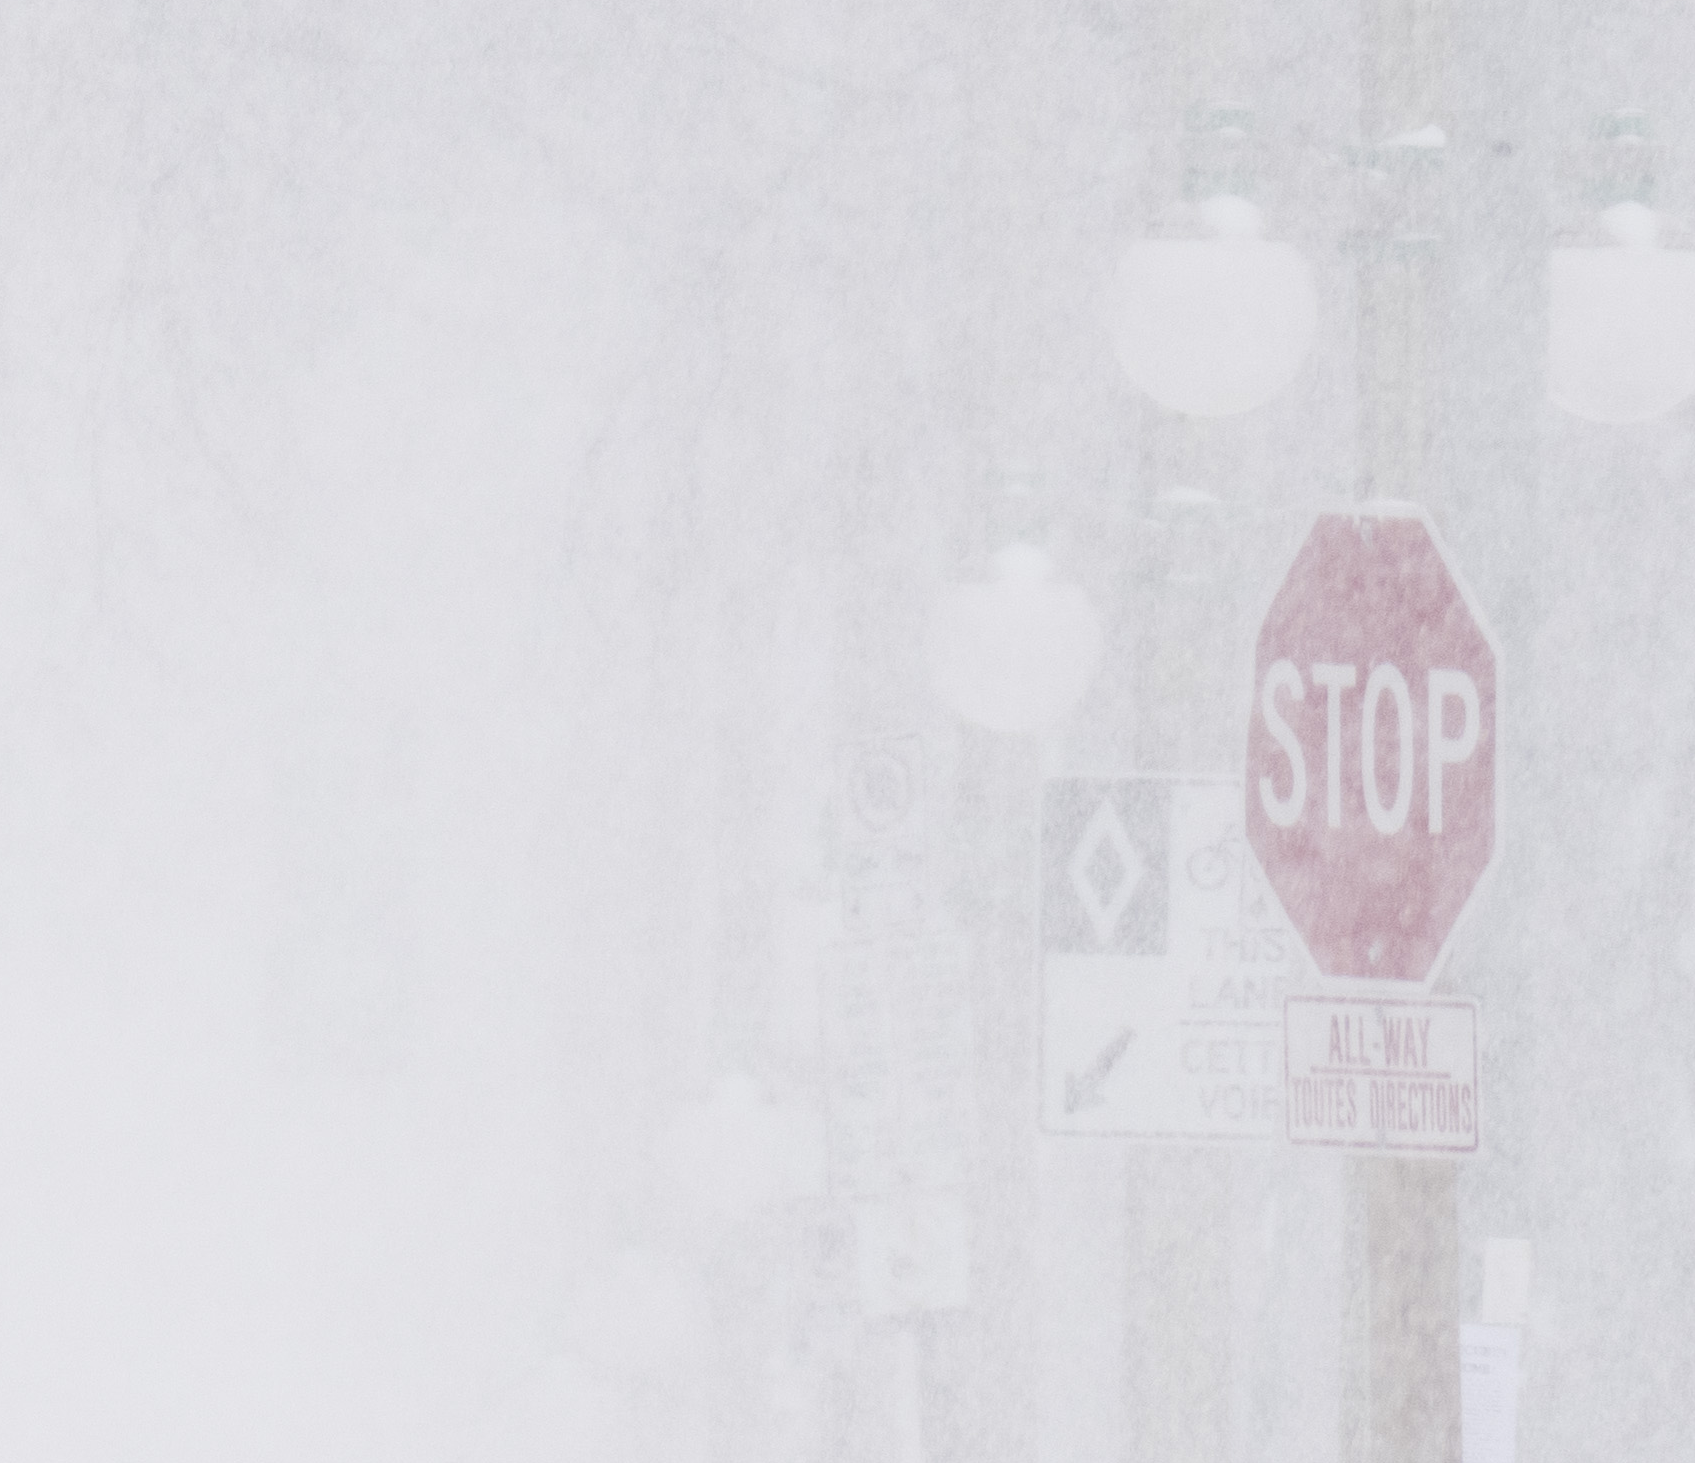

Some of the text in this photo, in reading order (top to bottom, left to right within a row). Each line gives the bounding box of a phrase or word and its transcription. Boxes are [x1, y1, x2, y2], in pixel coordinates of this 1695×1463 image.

[1259, 658, 1481, 836] STOP
[1200, 926, 1285, 962] THIS
[1180, 1039, 1277, 1075] CETT
[1329, 1013, 1432, 1069] ALL-WAY
[1292, 1078, 1474, 1134] TOUTES DIRECTIONS
